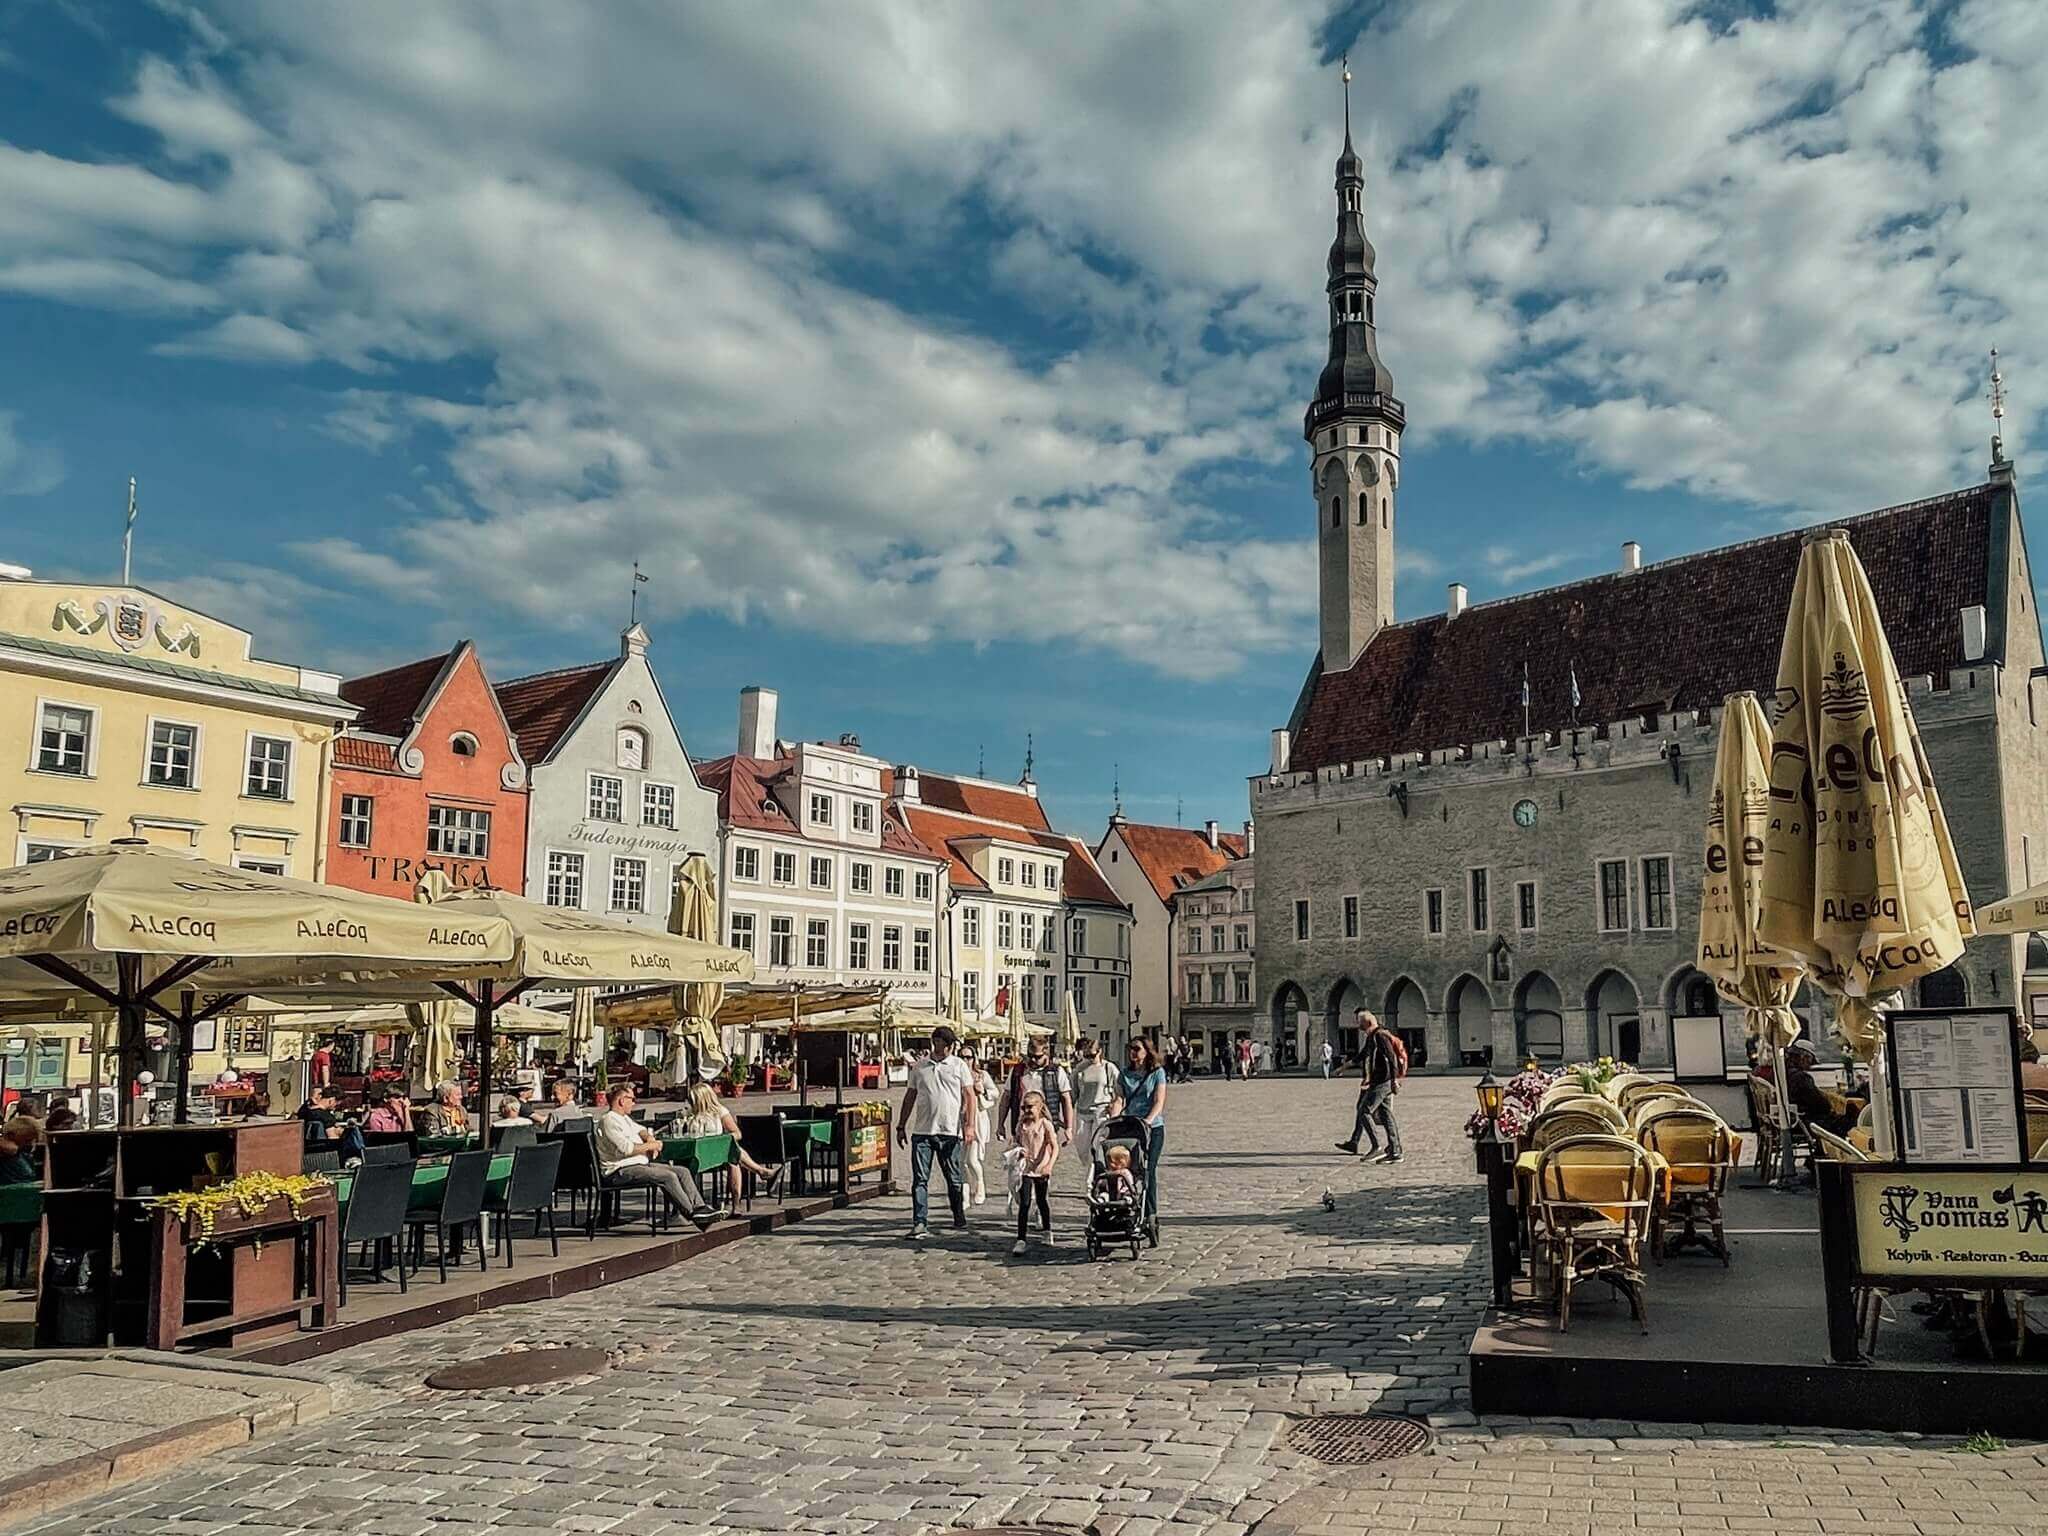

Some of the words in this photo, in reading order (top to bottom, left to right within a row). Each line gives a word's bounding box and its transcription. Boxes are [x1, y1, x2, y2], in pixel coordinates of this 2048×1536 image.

[568, 823, 688, 857] Tudengimaja
[358, 856, 491, 888] TROKA
[1923, 1191, 1979, 1209] Vana
